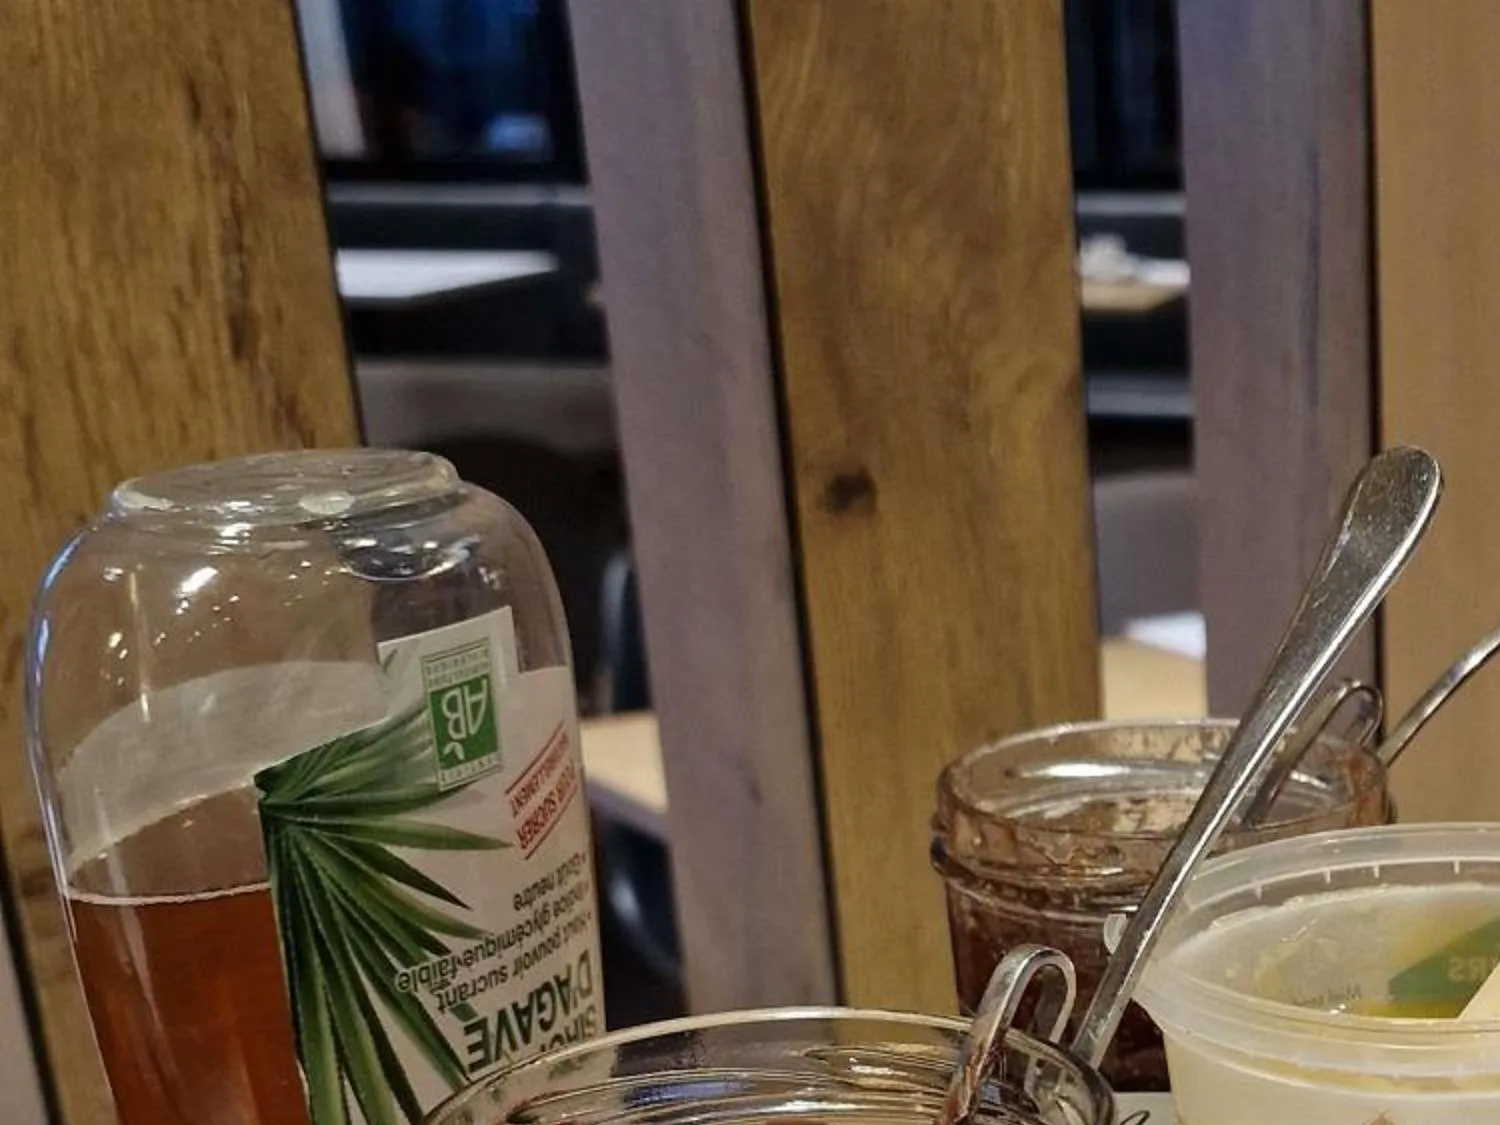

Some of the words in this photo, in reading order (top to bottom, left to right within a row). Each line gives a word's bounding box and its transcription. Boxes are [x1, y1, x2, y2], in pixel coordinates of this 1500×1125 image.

[512, 872, 558, 911] neutre
[460, 902, 552, 973] glycémique
[511, 932, 563, 978] pouvoir
[397, 957, 460, 993] faible
[436, 964, 510, 1016] sucrant
[462, 949, 594, 1074] D'AGAVE
